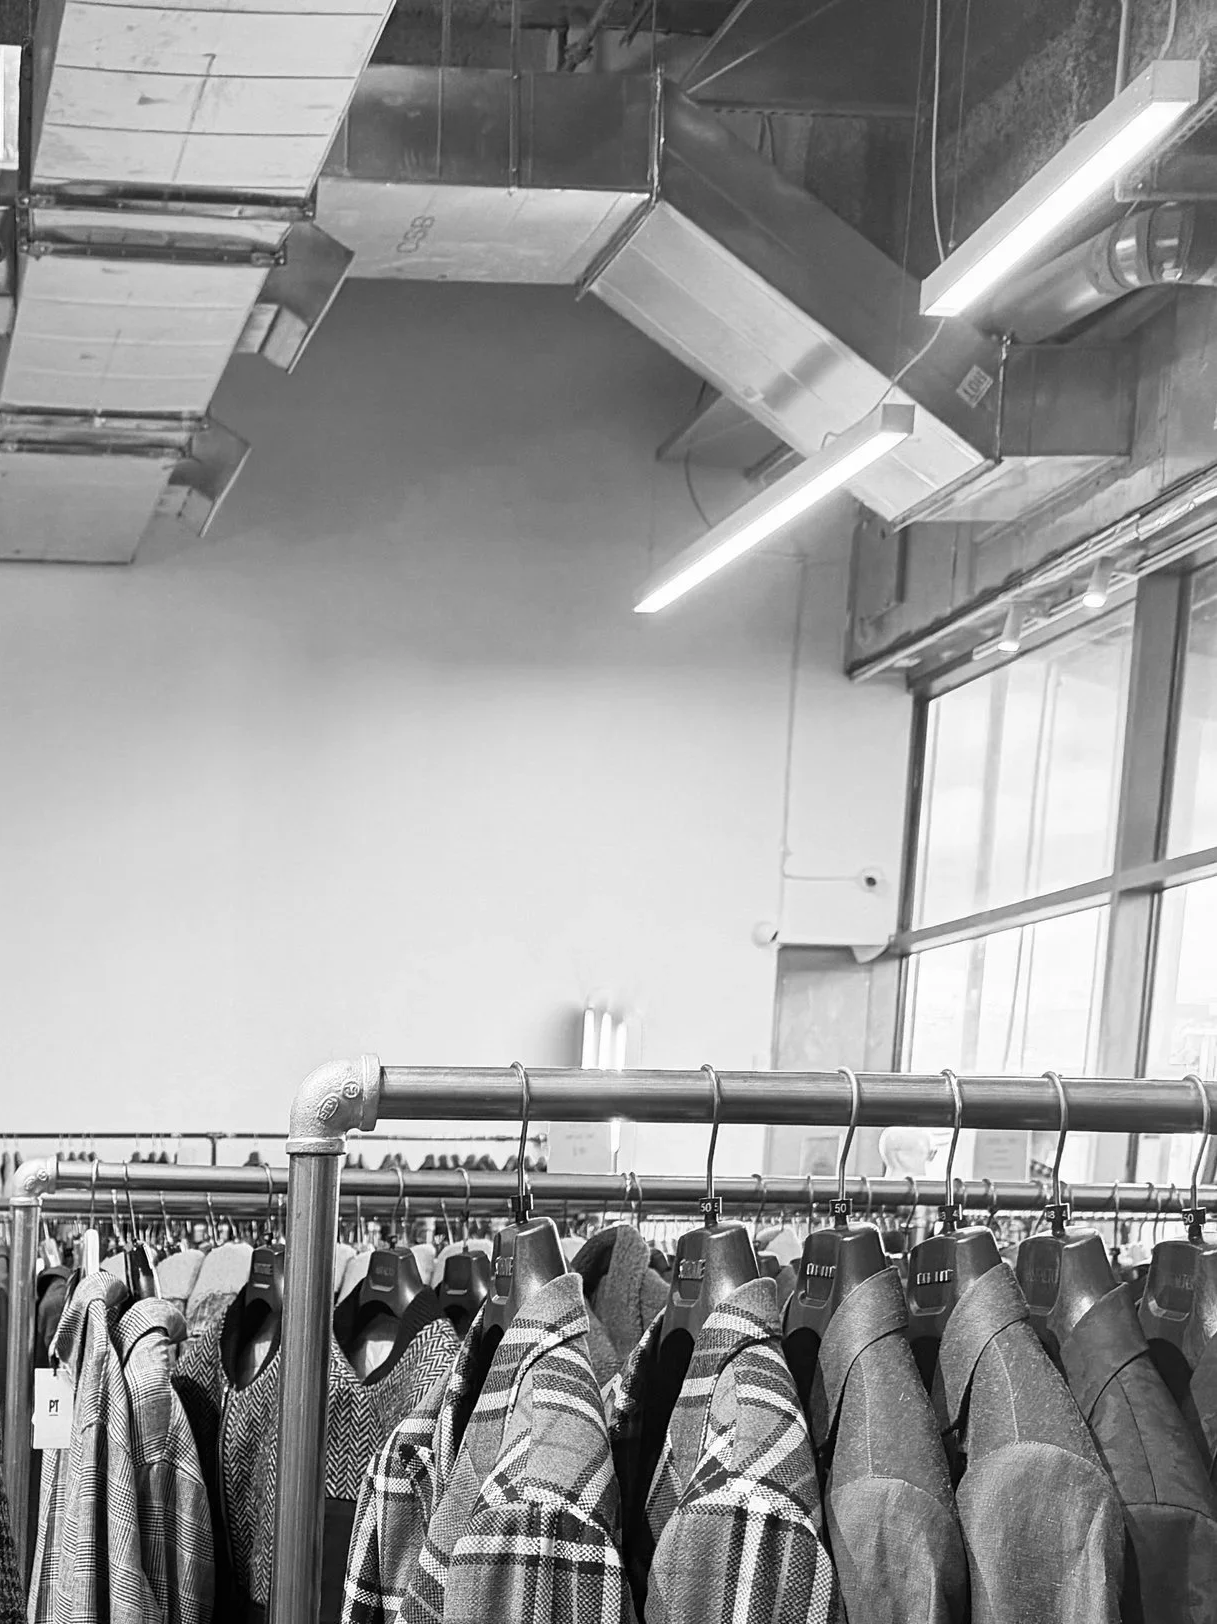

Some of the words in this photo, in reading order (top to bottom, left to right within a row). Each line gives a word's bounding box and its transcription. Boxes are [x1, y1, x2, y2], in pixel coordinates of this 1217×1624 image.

[700, 1202, 712, 1213] 50
[834, 1203, 847, 1214] 50
[48, 1399, 60, 1413] PT
